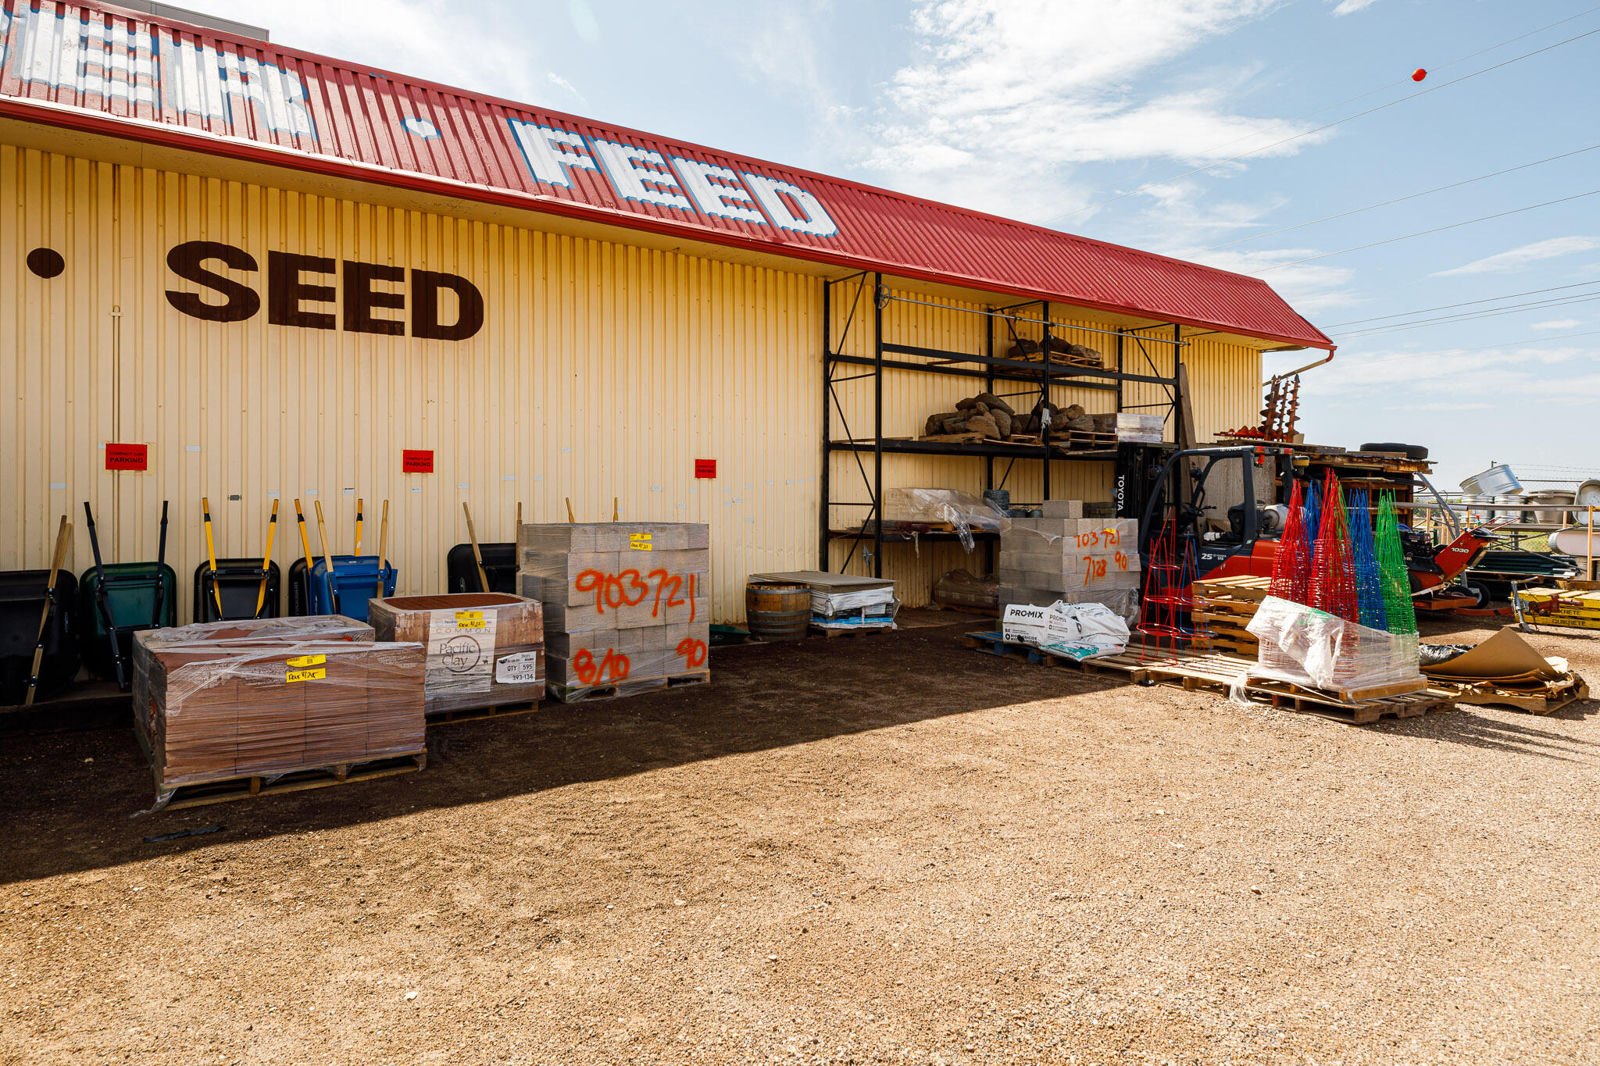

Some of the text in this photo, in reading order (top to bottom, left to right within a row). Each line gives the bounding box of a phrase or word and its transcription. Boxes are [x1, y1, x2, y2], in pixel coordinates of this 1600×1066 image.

[507, 117, 839, 238] FEED
[165, 240, 484, 341] SEED
[1117, 474, 1125, 511] TOYOTA
[1114, 551, 1127, 571] 90
[439, 641, 475, 654] Pacific
[442, 653, 468, 669] Clay
[573, 637, 707, 686] 8/10 90
